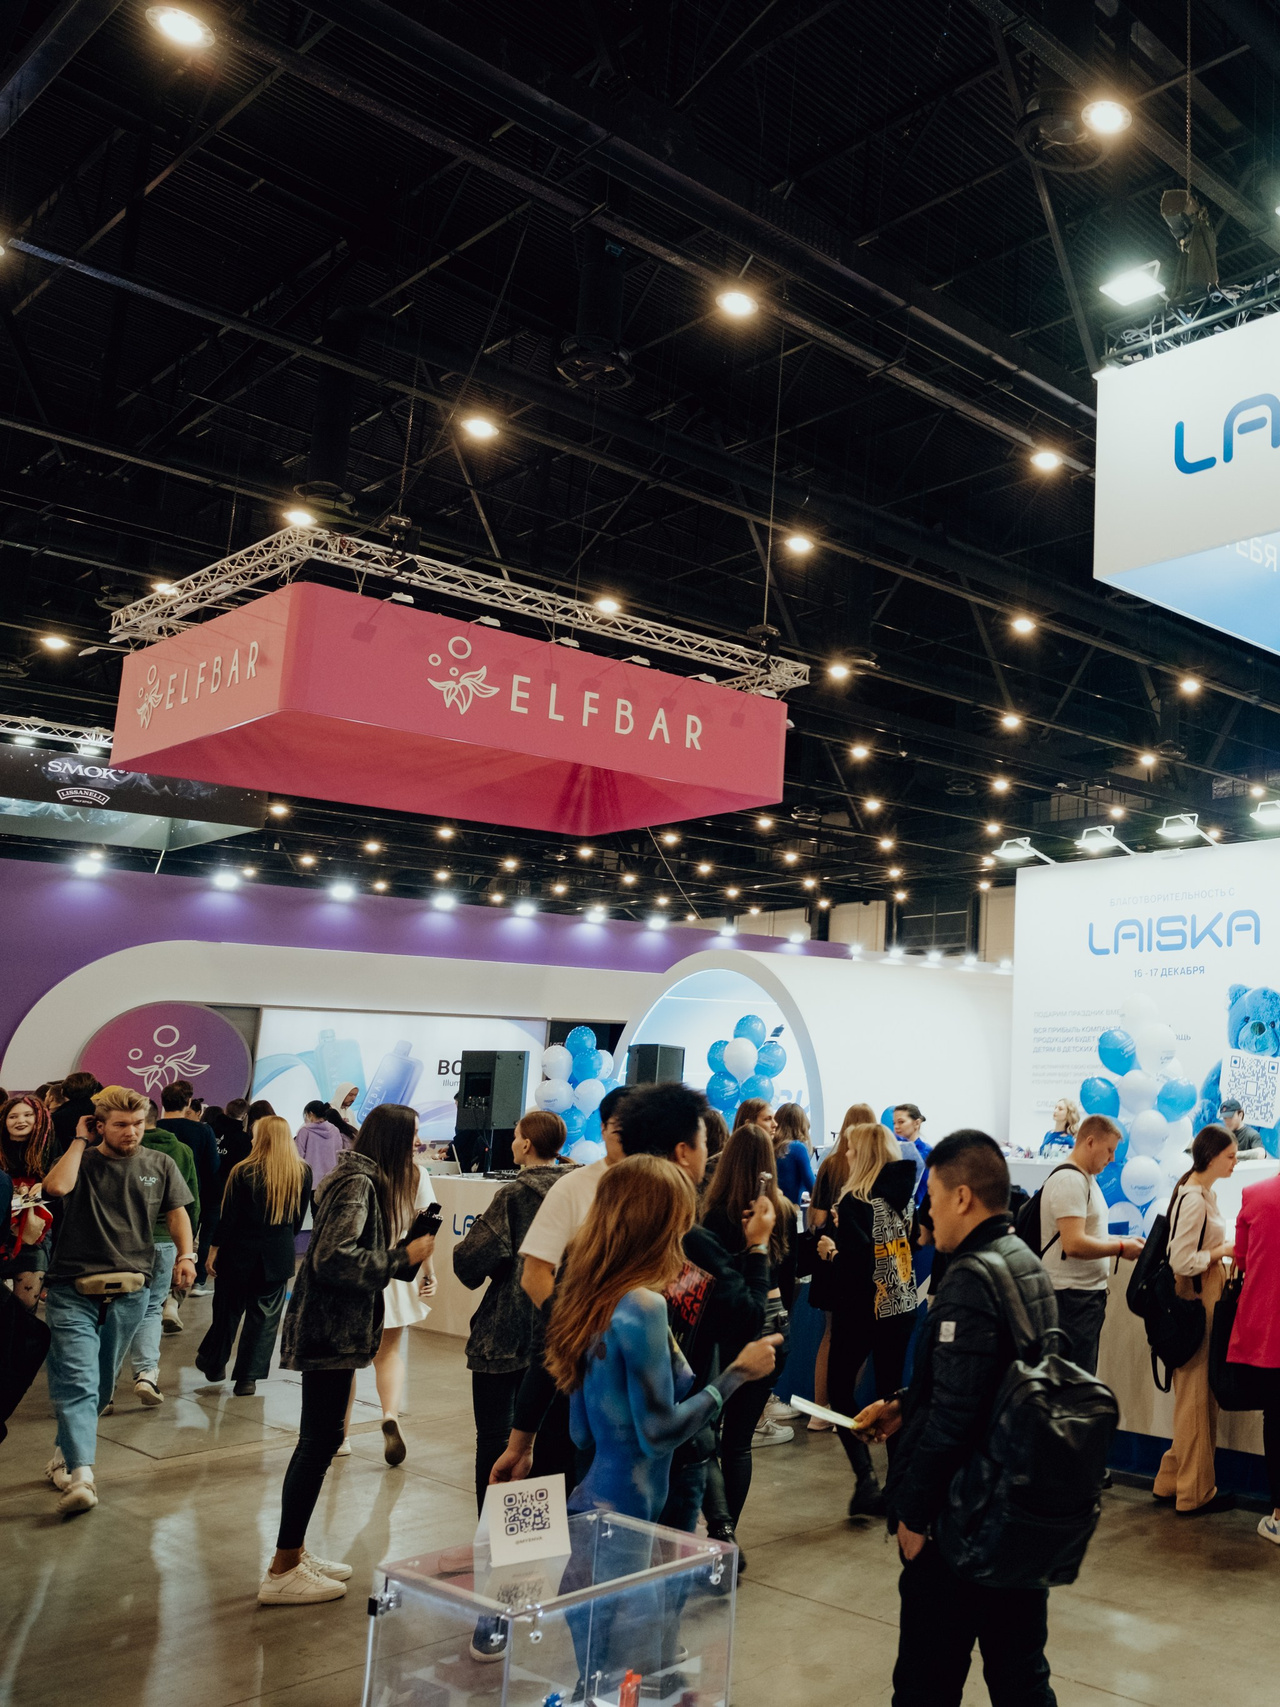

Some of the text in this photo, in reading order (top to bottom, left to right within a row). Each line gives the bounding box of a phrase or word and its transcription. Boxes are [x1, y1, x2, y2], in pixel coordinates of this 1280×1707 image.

[165, 640, 259, 710] ELFBAR
[510, 674, 702, 751] ELFBAR
[47, 760, 120, 782] SMOK
[1088, 908, 1261, 956] LAISKA
[1160, 965, 1206, 978] ДЕКАБРЯ
